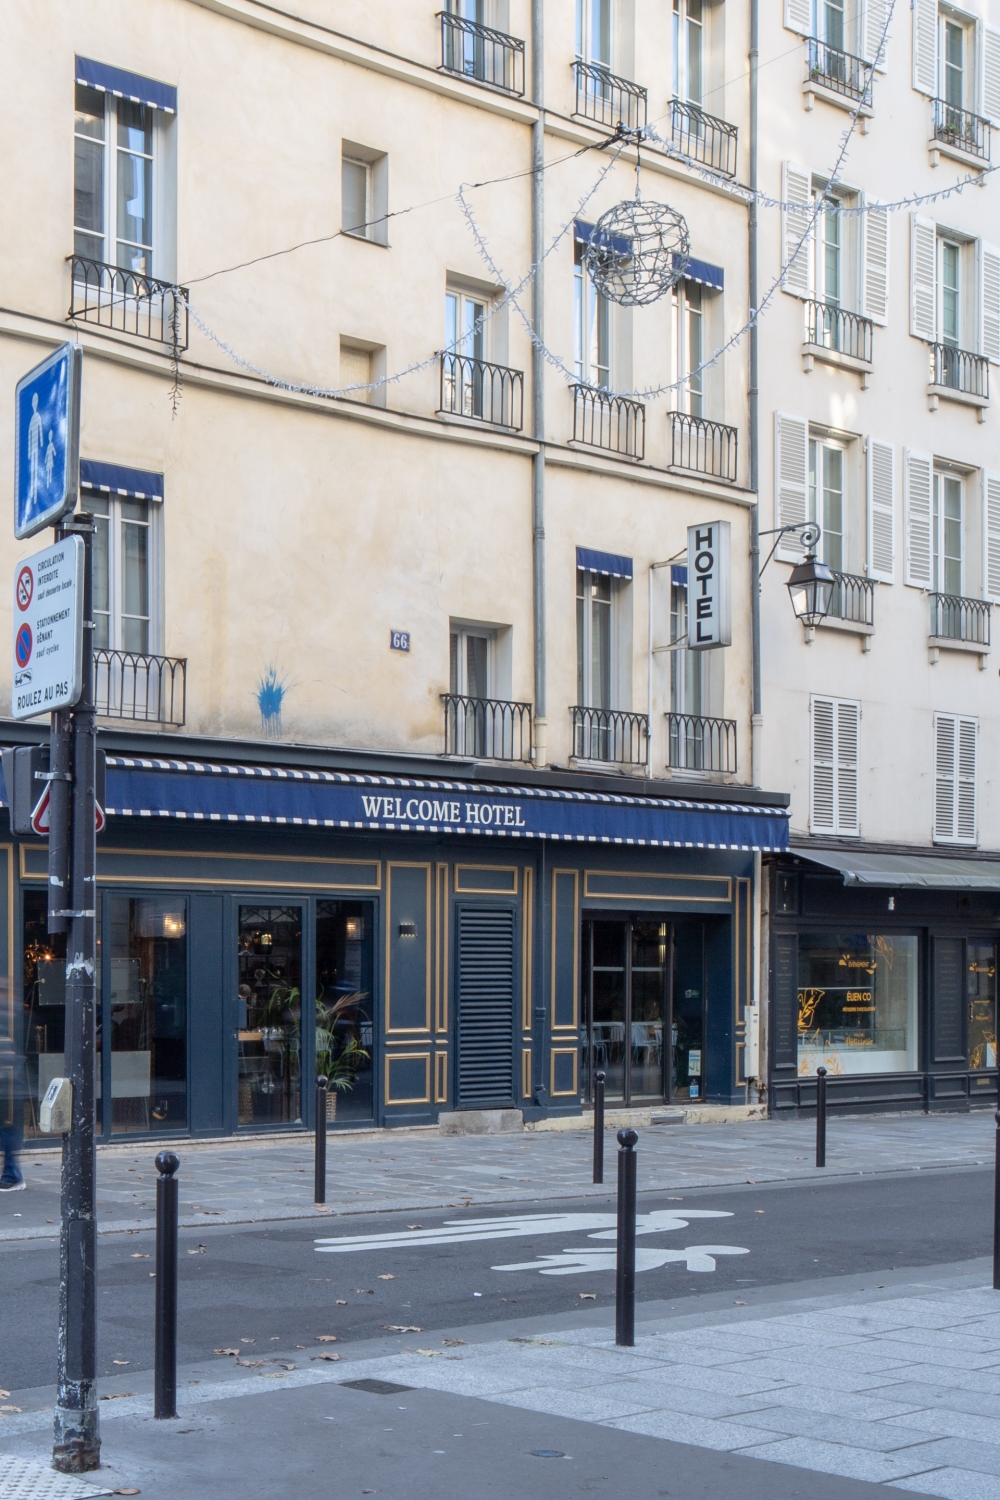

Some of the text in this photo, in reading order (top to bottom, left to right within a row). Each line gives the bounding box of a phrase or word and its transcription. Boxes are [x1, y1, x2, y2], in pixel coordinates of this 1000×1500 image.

[38, 551, 65, 572] CIRCULATION
[37, 569, 59, 586] INTERDITE
[695, 527, 714, 642] HOTEL
[37, 578, 73, 601] sauf desserte locale
[37, 608, 70, 629] STATIONNEMENT
[36, 629, 53, 644] GÊNANT
[36, 643, 60, 658] sauf cycles
[17, 681, 68, 710] ROULEZ AU PAS
[361, 795, 526, 827] WELCOME HOTEL
[862, 992, 872, 1001] CO
